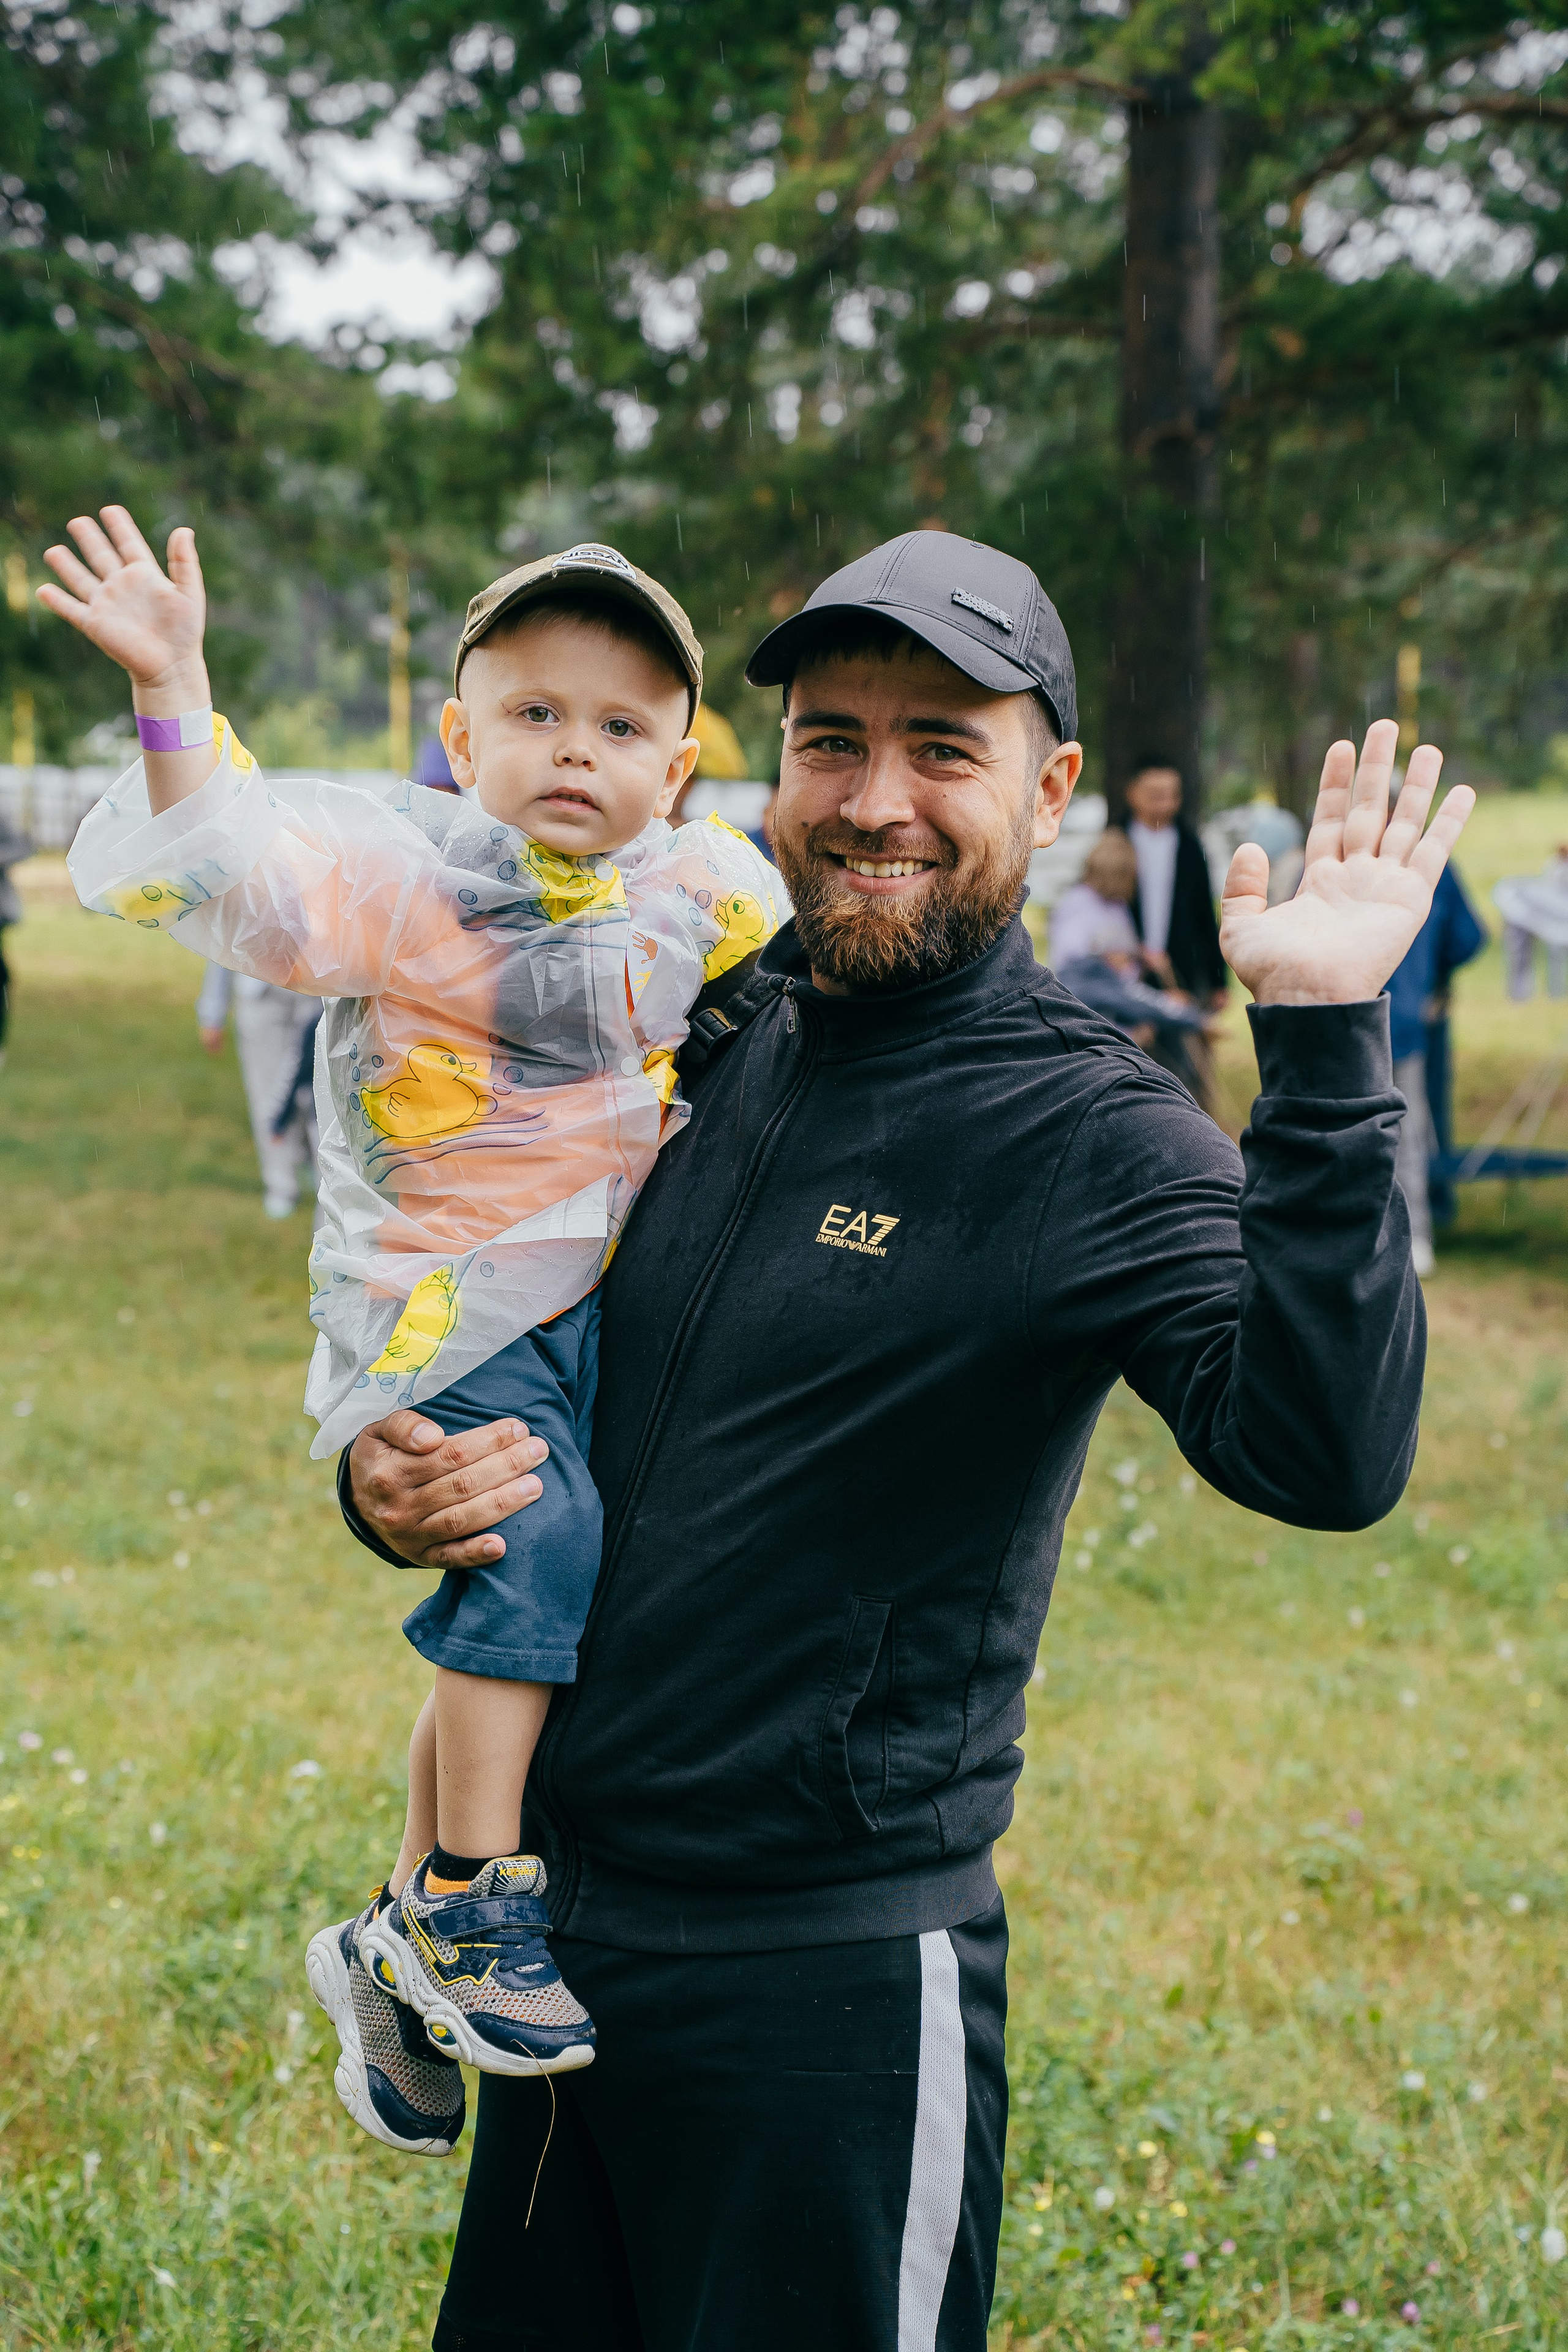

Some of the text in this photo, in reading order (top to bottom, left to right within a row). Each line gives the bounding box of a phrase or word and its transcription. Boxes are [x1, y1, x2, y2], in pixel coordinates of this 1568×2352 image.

[562, 552, 628, 570] NISSAN
[820, 1204, 900, 1246] EA7
[815, 1234, 888, 1257] EMPORIO ARMANI
[499, 1865, 537, 1879] kapika
